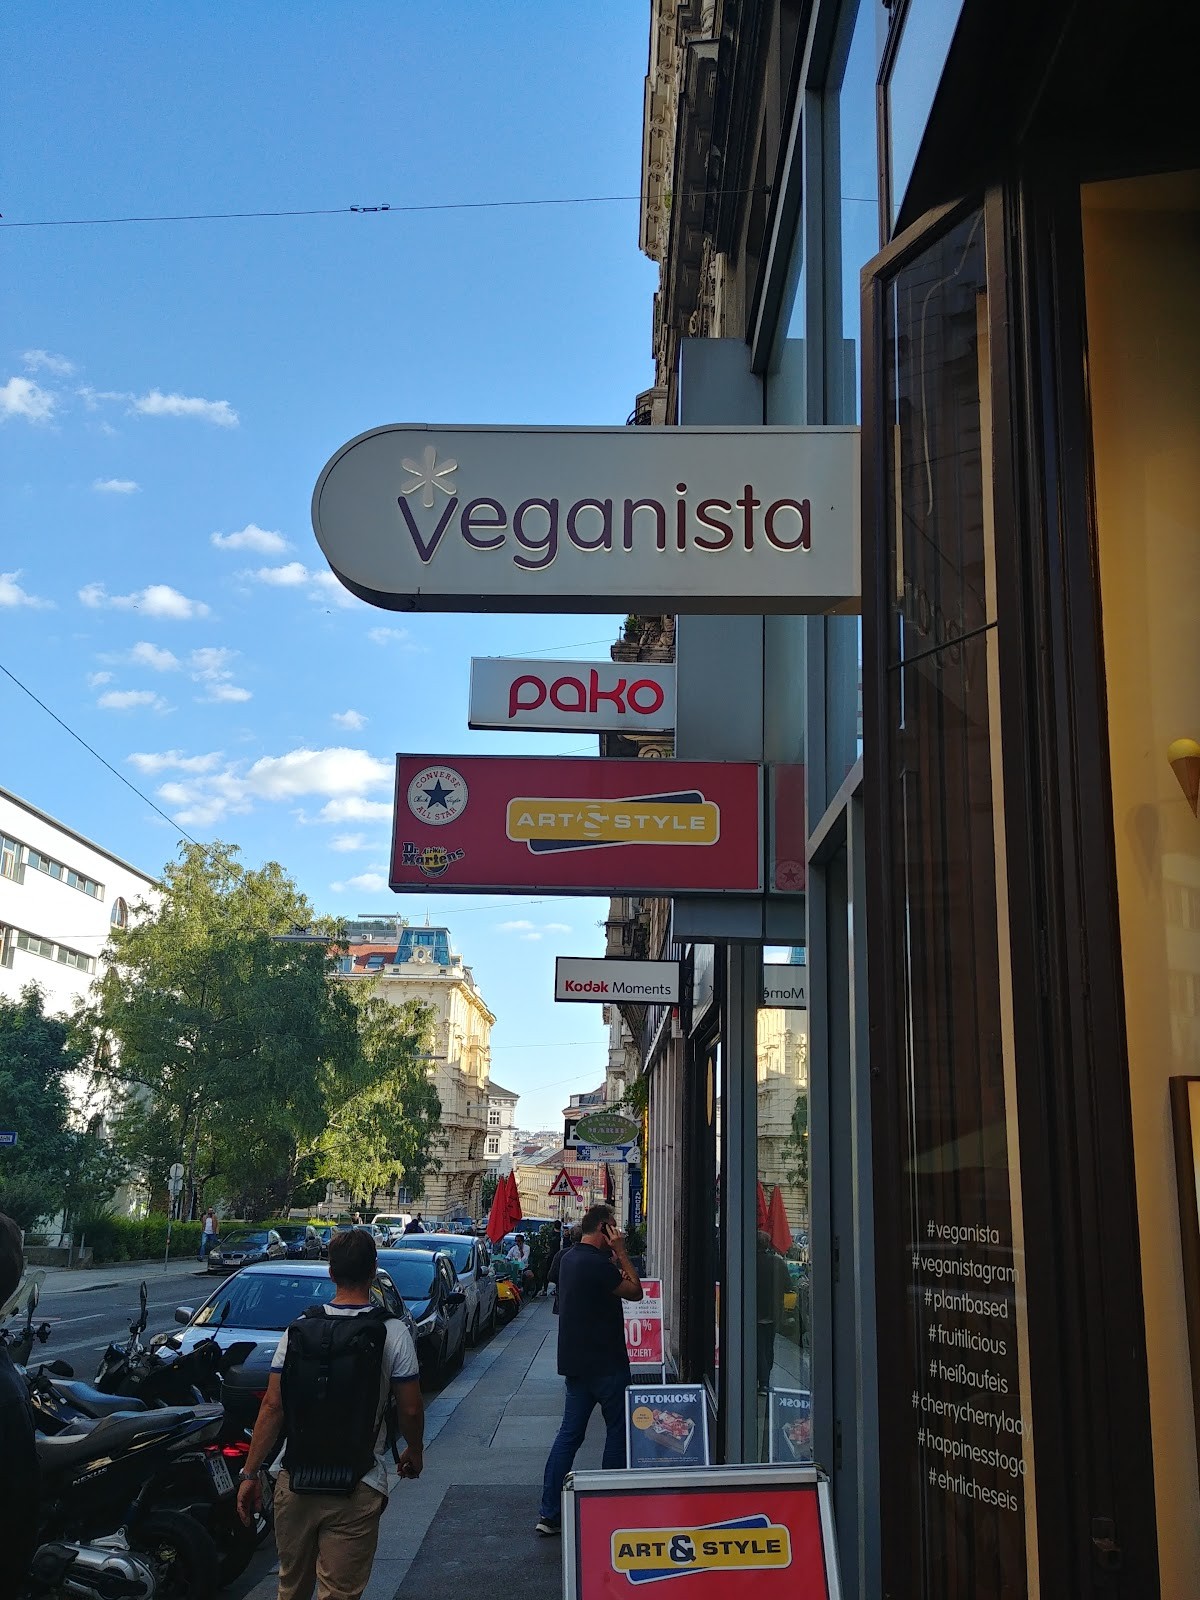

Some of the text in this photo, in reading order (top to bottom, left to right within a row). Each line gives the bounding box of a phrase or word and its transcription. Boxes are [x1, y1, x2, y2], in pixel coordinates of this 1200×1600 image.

[508, 669, 664, 718] pako
[415, 771, 461, 789] CONVERSE
[416, 806, 457, 821] ALL STAR
[516, 812, 574, 827] ART
[614, 814, 706, 830] STYLE
[402, 848, 465, 866] Martens
[565, 980, 671, 996] Kodak Moments
[927, 1220, 1000, 1244] #veganista
[912, 1252, 1020, 1284] #veganistagram
[924, 1288, 1009, 1319] #plantbased
[928, 1323, 1007, 1356] #fruitilicious
[929, 1358, 1009, 1393] #heißaufeis
[634, 1394, 697, 1404] FOTOKIOSK
[911, 1390, 1032, 1441] #cherrycherrylady
[918, 1427, 1027, 1477] #happinesstogo
[928, 1468, 1018, 1512] #ehrlicheseis
[617, 1534, 782, 1562] ART & STYLE
